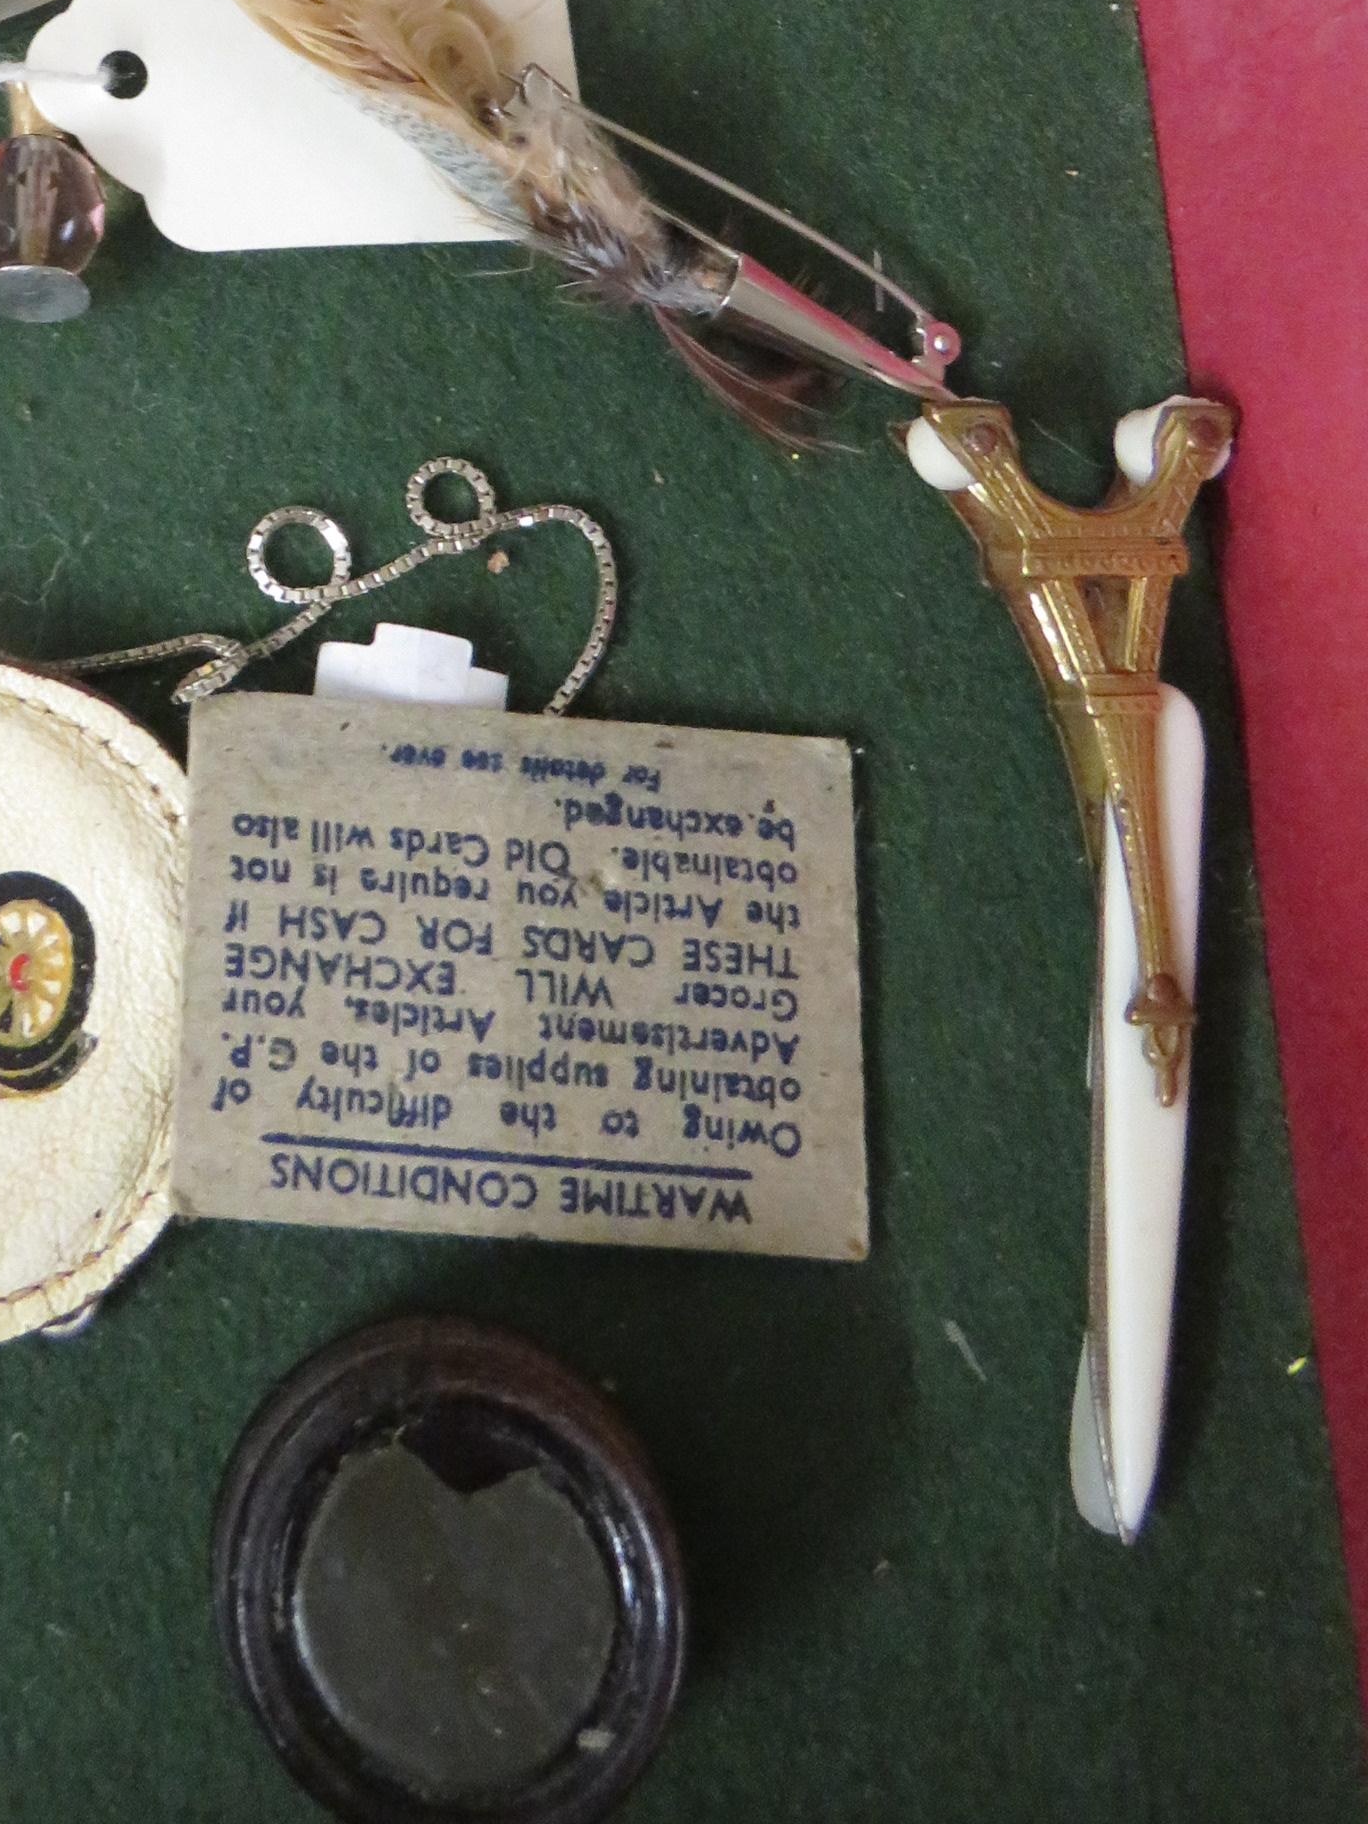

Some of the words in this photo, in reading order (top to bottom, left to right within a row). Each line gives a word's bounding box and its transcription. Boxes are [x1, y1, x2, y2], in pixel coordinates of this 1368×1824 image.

[380, 743, 449, 769] over.
[460, 749, 503, 773] see
[519, 756, 607, 786] details
[622, 765, 661, 793] For
[232, 813, 300, 848] also
[554, 792, 744, 840] exchanged.
[311, 819, 375, 854] will
[389, 827, 490, 868] Cards
[230, 855, 291, 884] not
[505, 839, 571, 878] Old
[611, 847, 798, 892] obtainable.
[313, 863, 338, 895] is
[360, 867, 490, 903] require
[516, 873, 580, 911] you
[223, 899, 249, 933] if
[279, 904, 387, 945] CASH
[605, 891, 724, 928] Article
[746, 901, 800, 934] the
[416, 915, 493, 956] FOR
[522, 925, 656, 968] CARDS
[224, 943, 457, 996] EXCHANGE
[682, 938, 800, 980] THESE
[222, 985, 306, 1018] your
[515, 968, 614, 1008] WILL
[673, 982, 799, 1023] Grocer
[221, 1032, 297, 1072] G.P.
[539, 1012, 800, 1066] Advertisement
[320, 1040, 379, 1077] the
[404, 1048, 442, 1081] of
[466, 1048, 609, 1091] supplies
[211, 1076, 252, 1112] of
[633, 1056, 802, 1109] obtaining
[295, 1075, 453, 1130] difficulty
[499, 1101, 557, 1138] the
[599, 1108, 640, 1138] to
[682, 1103, 802, 1159] Owing
[270, 1153, 538, 1209] CONDITIONS
[560, 1177, 753, 1224] WARTIME
